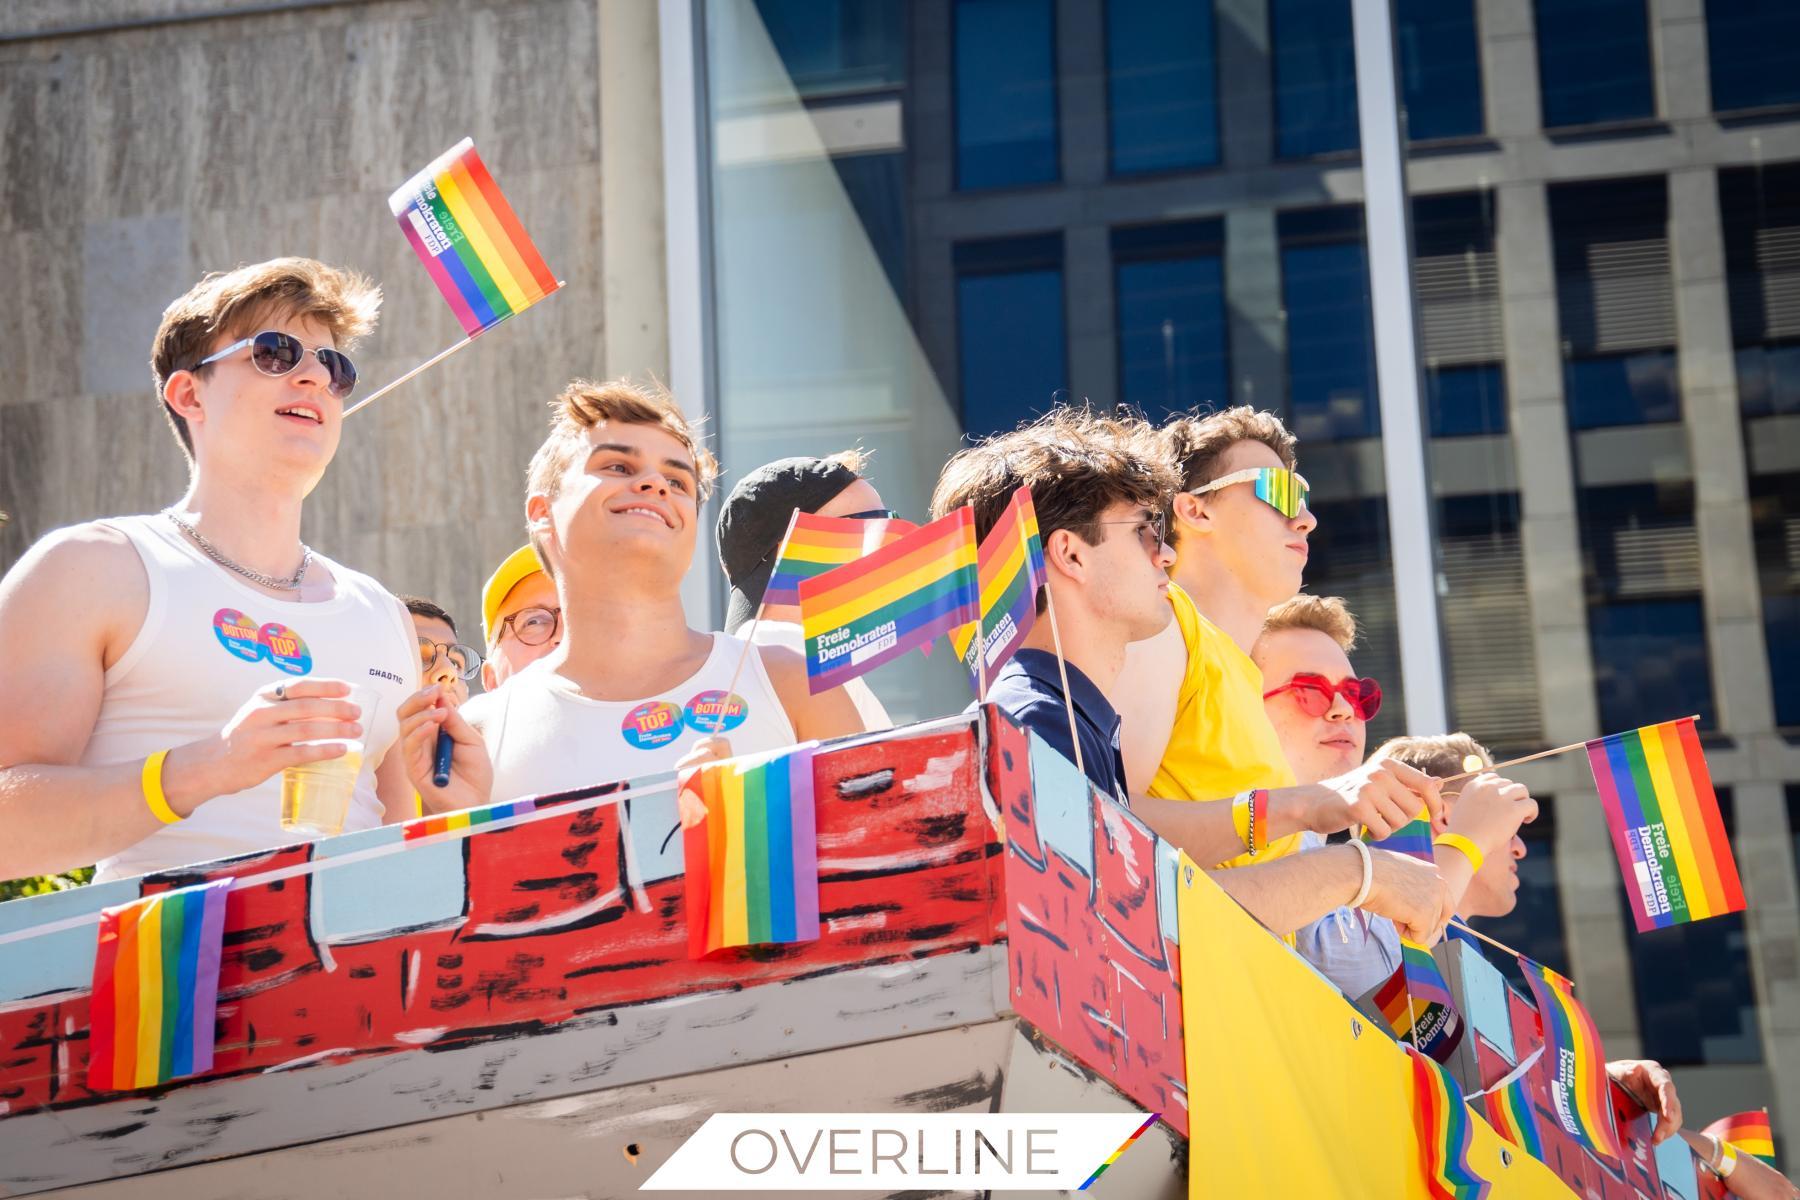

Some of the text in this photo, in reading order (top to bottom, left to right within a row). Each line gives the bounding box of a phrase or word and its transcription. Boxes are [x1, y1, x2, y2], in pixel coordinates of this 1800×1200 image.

[415, 191, 452, 250] mokraten
[425, 235, 439, 252] FDP
[221, 623, 258, 642] BOTTOM
[816, 627, 850, 649] Freie
[818, 620, 896, 664] Demokraten
[878, 635, 895, 650] FDP
[269, 636, 297, 657] TOP
[369, 668, 403, 685] CHAOTIC
[636, 712, 669, 732] TOP
[1652, 822, 1669, 858] Freie
[1638, 825, 1671, 915] Demokraten
[1645, 892, 1657, 914] FDP
[1567, 1050, 1576, 1088] Freie
